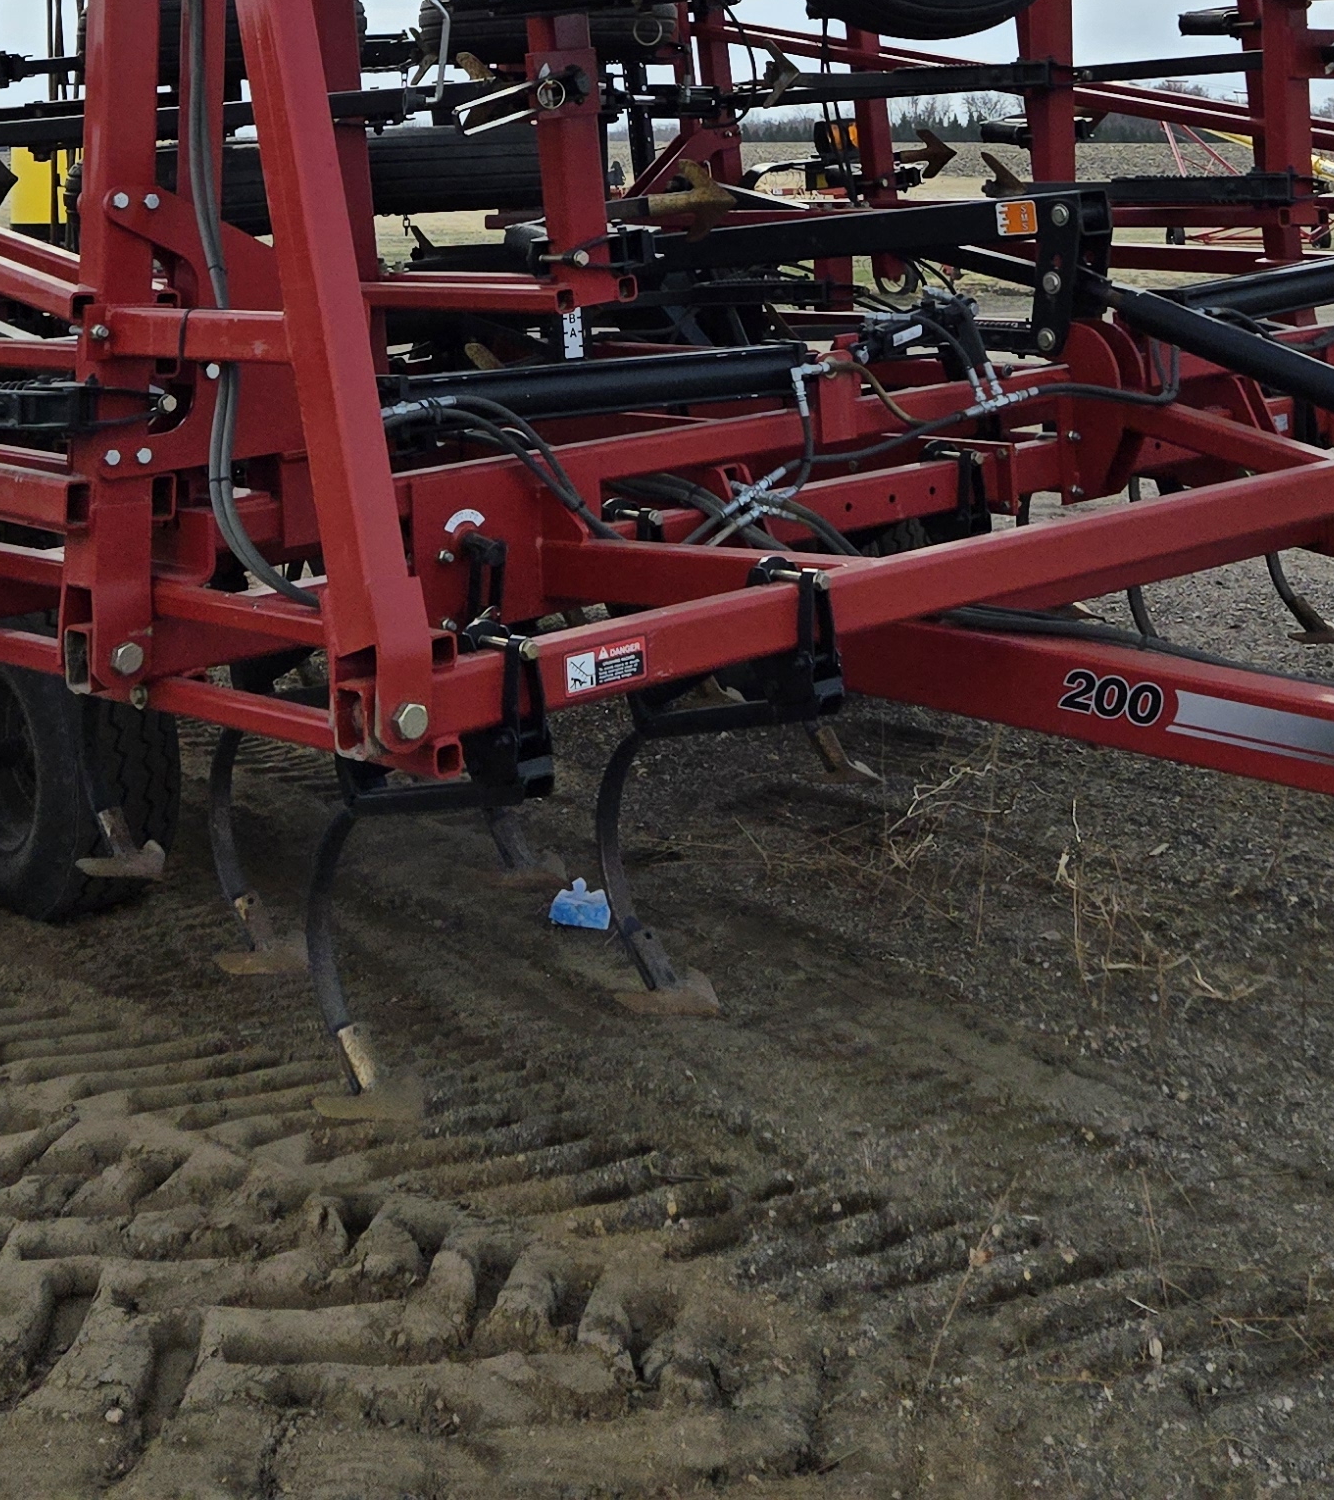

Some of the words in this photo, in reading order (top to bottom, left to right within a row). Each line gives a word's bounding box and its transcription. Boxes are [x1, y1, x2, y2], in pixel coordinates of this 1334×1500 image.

[568, 313, 576, 324] B
[569, 327, 578, 338] A
[609, 642, 641, 657] DANGER
[1057, 668, 1164, 727] 200
